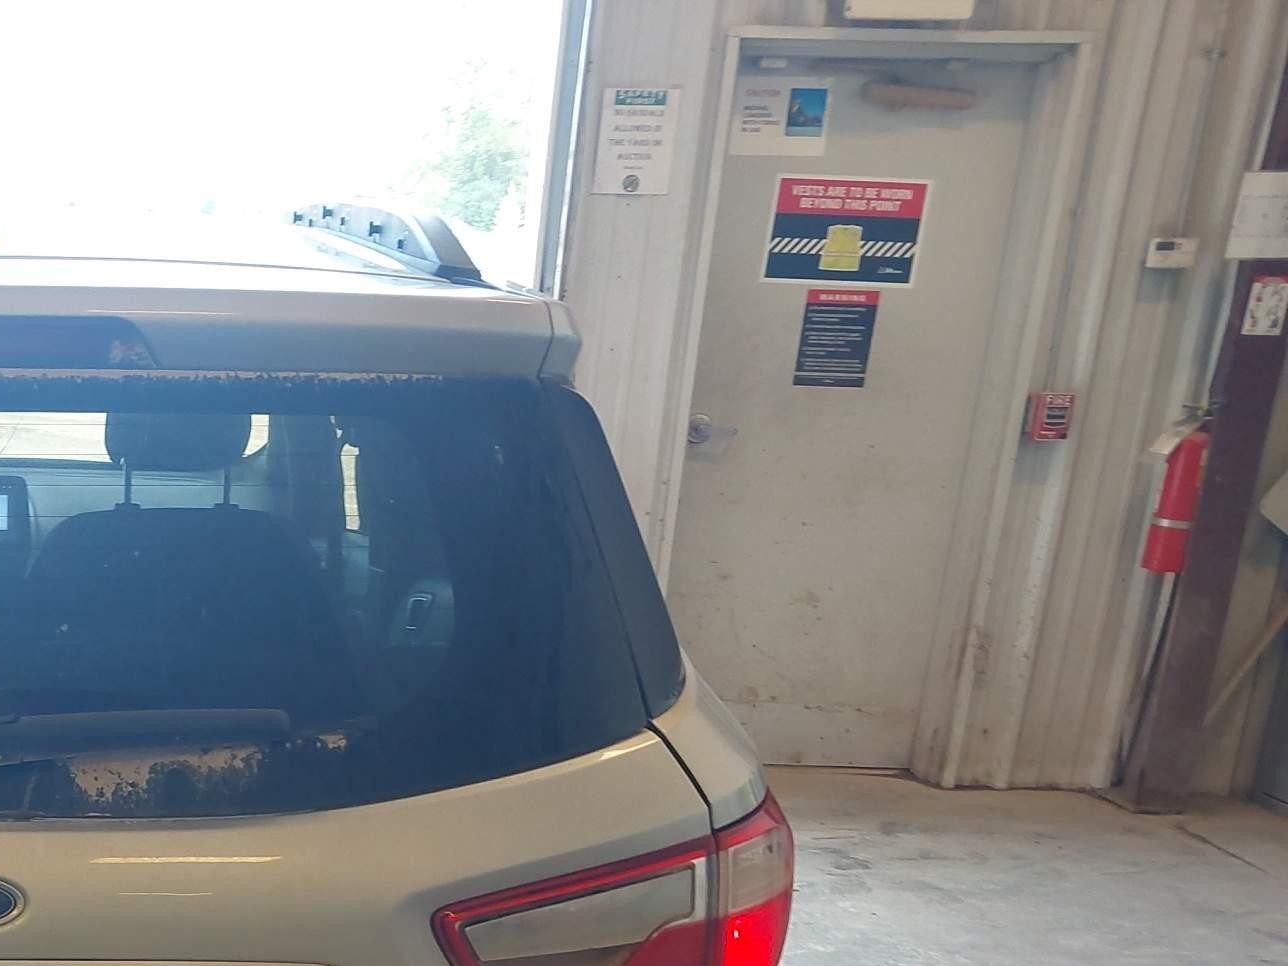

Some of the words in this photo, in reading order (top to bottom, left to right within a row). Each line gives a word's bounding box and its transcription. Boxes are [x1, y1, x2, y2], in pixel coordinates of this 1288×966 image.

[792, 185, 825, 196] VESTS
[826, 186, 847, 197] ARE
[849, 187, 863, 198] TO
[864, 188, 879, 198] BE
[880, 189, 914, 200] WORN
[800, 198, 842, 209] BEYOND
[844, 199, 868, 210] THIS
[869, 200, 902, 212] POINT
[819, 294, 866, 302] WARNING
[1046, 395, 1073, 405] FIRE
